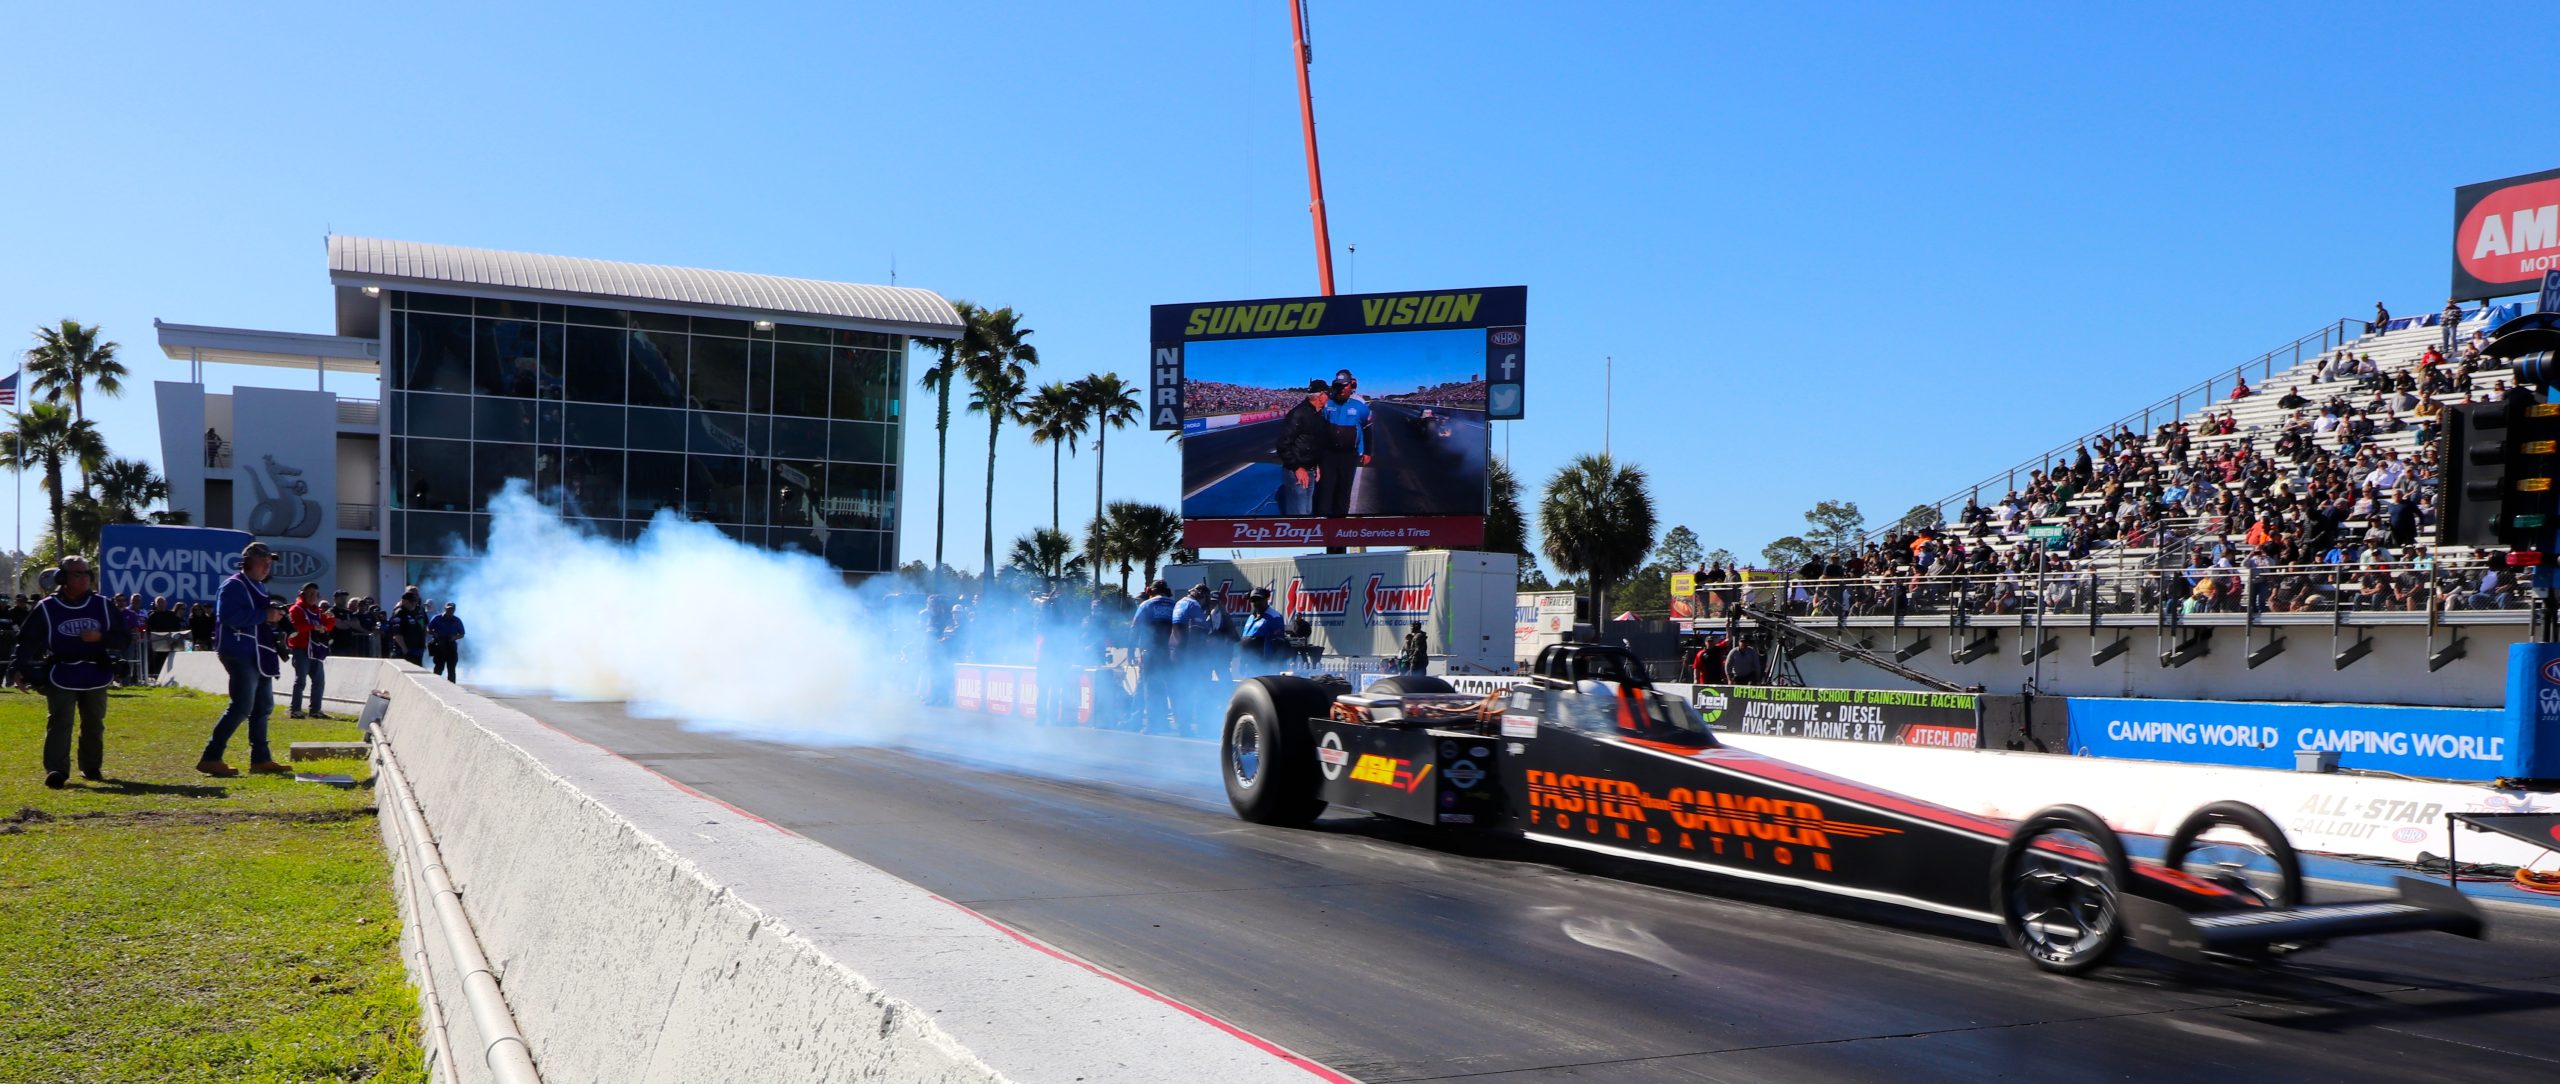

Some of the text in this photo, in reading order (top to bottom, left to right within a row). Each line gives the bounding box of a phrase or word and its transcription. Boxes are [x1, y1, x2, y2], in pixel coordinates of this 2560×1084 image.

[2472, 204, 2560, 260] AM
[1184, 293, 1483, 336] SUNOCO VISION
[1493, 333, 1521, 345] NHRA
[1156, 347, 1180, 426] NHRA
[1232, 523, 1431, 543] Pep Boys Auto Service & Tires
[106, 546, 241, 575] CAMPING
[271, 555, 317, 577] HRA
[107, 570, 218, 601] WORL
[1733, 687, 1766, 700] OFFICIAL
[1770, 688, 1815, 702] TECHNICAL
[1817, 690, 1851, 704] SCHOOL
[1854, 691, 1866, 704] OF
[1867, 691, 1928, 707] GAINESVILLE
[2539, 700, 2560, 715] W
[1744, 701, 1884, 724] AUTOMOTIVE DIESEL
[1741, 717, 1784, 734] HVAC-R
[1803, 721, 1849, 740] MARINE
[1853, 723, 1863, 740] &
[1867, 725, 1886, 742] RV
[1911, 728, 1977, 748] JTECH.ORG
[2107, 719, 2279, 749] CAMPING WORLD
[2297, 727, 2504, 761] CAMPING WORLD
[1526, 769, 1647, 822] FASTER
[1668, 786, 1833, 850] CANCER
[2298, 793, 2443, 825] ALL STAR
[1530, 809, 1833, 872] FOUNDATION
[2397, 828, 2424, 841] NHRA
